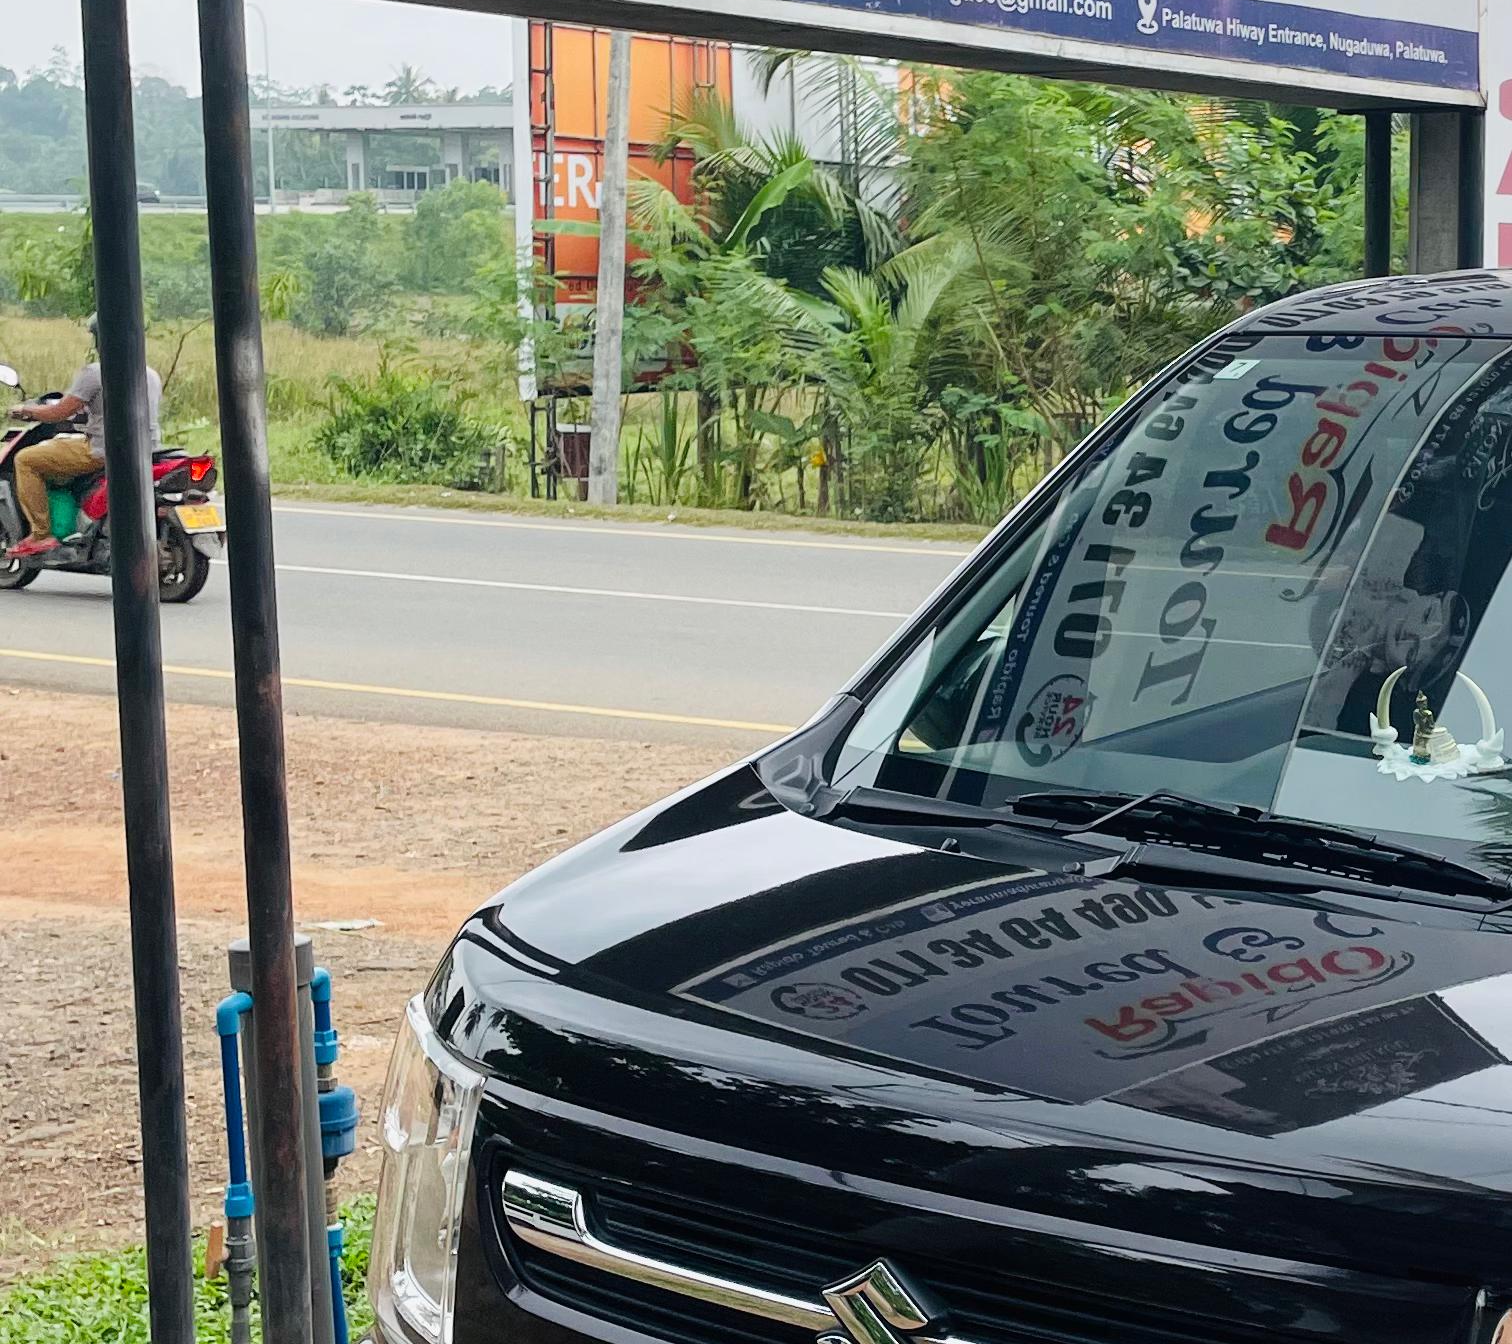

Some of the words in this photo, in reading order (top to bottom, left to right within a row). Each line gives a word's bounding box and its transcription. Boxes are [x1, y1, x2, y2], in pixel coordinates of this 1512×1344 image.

[1161, 7, 1224, 36] Palatuwa
[1227, 19, 1265, 46] Hiway
[1268, 23, 1327, 52] Entrance,
[1329, 31, 1394, 61] Nugaduwa,
[1395, 40, 1449, 65] Palatuwa.
